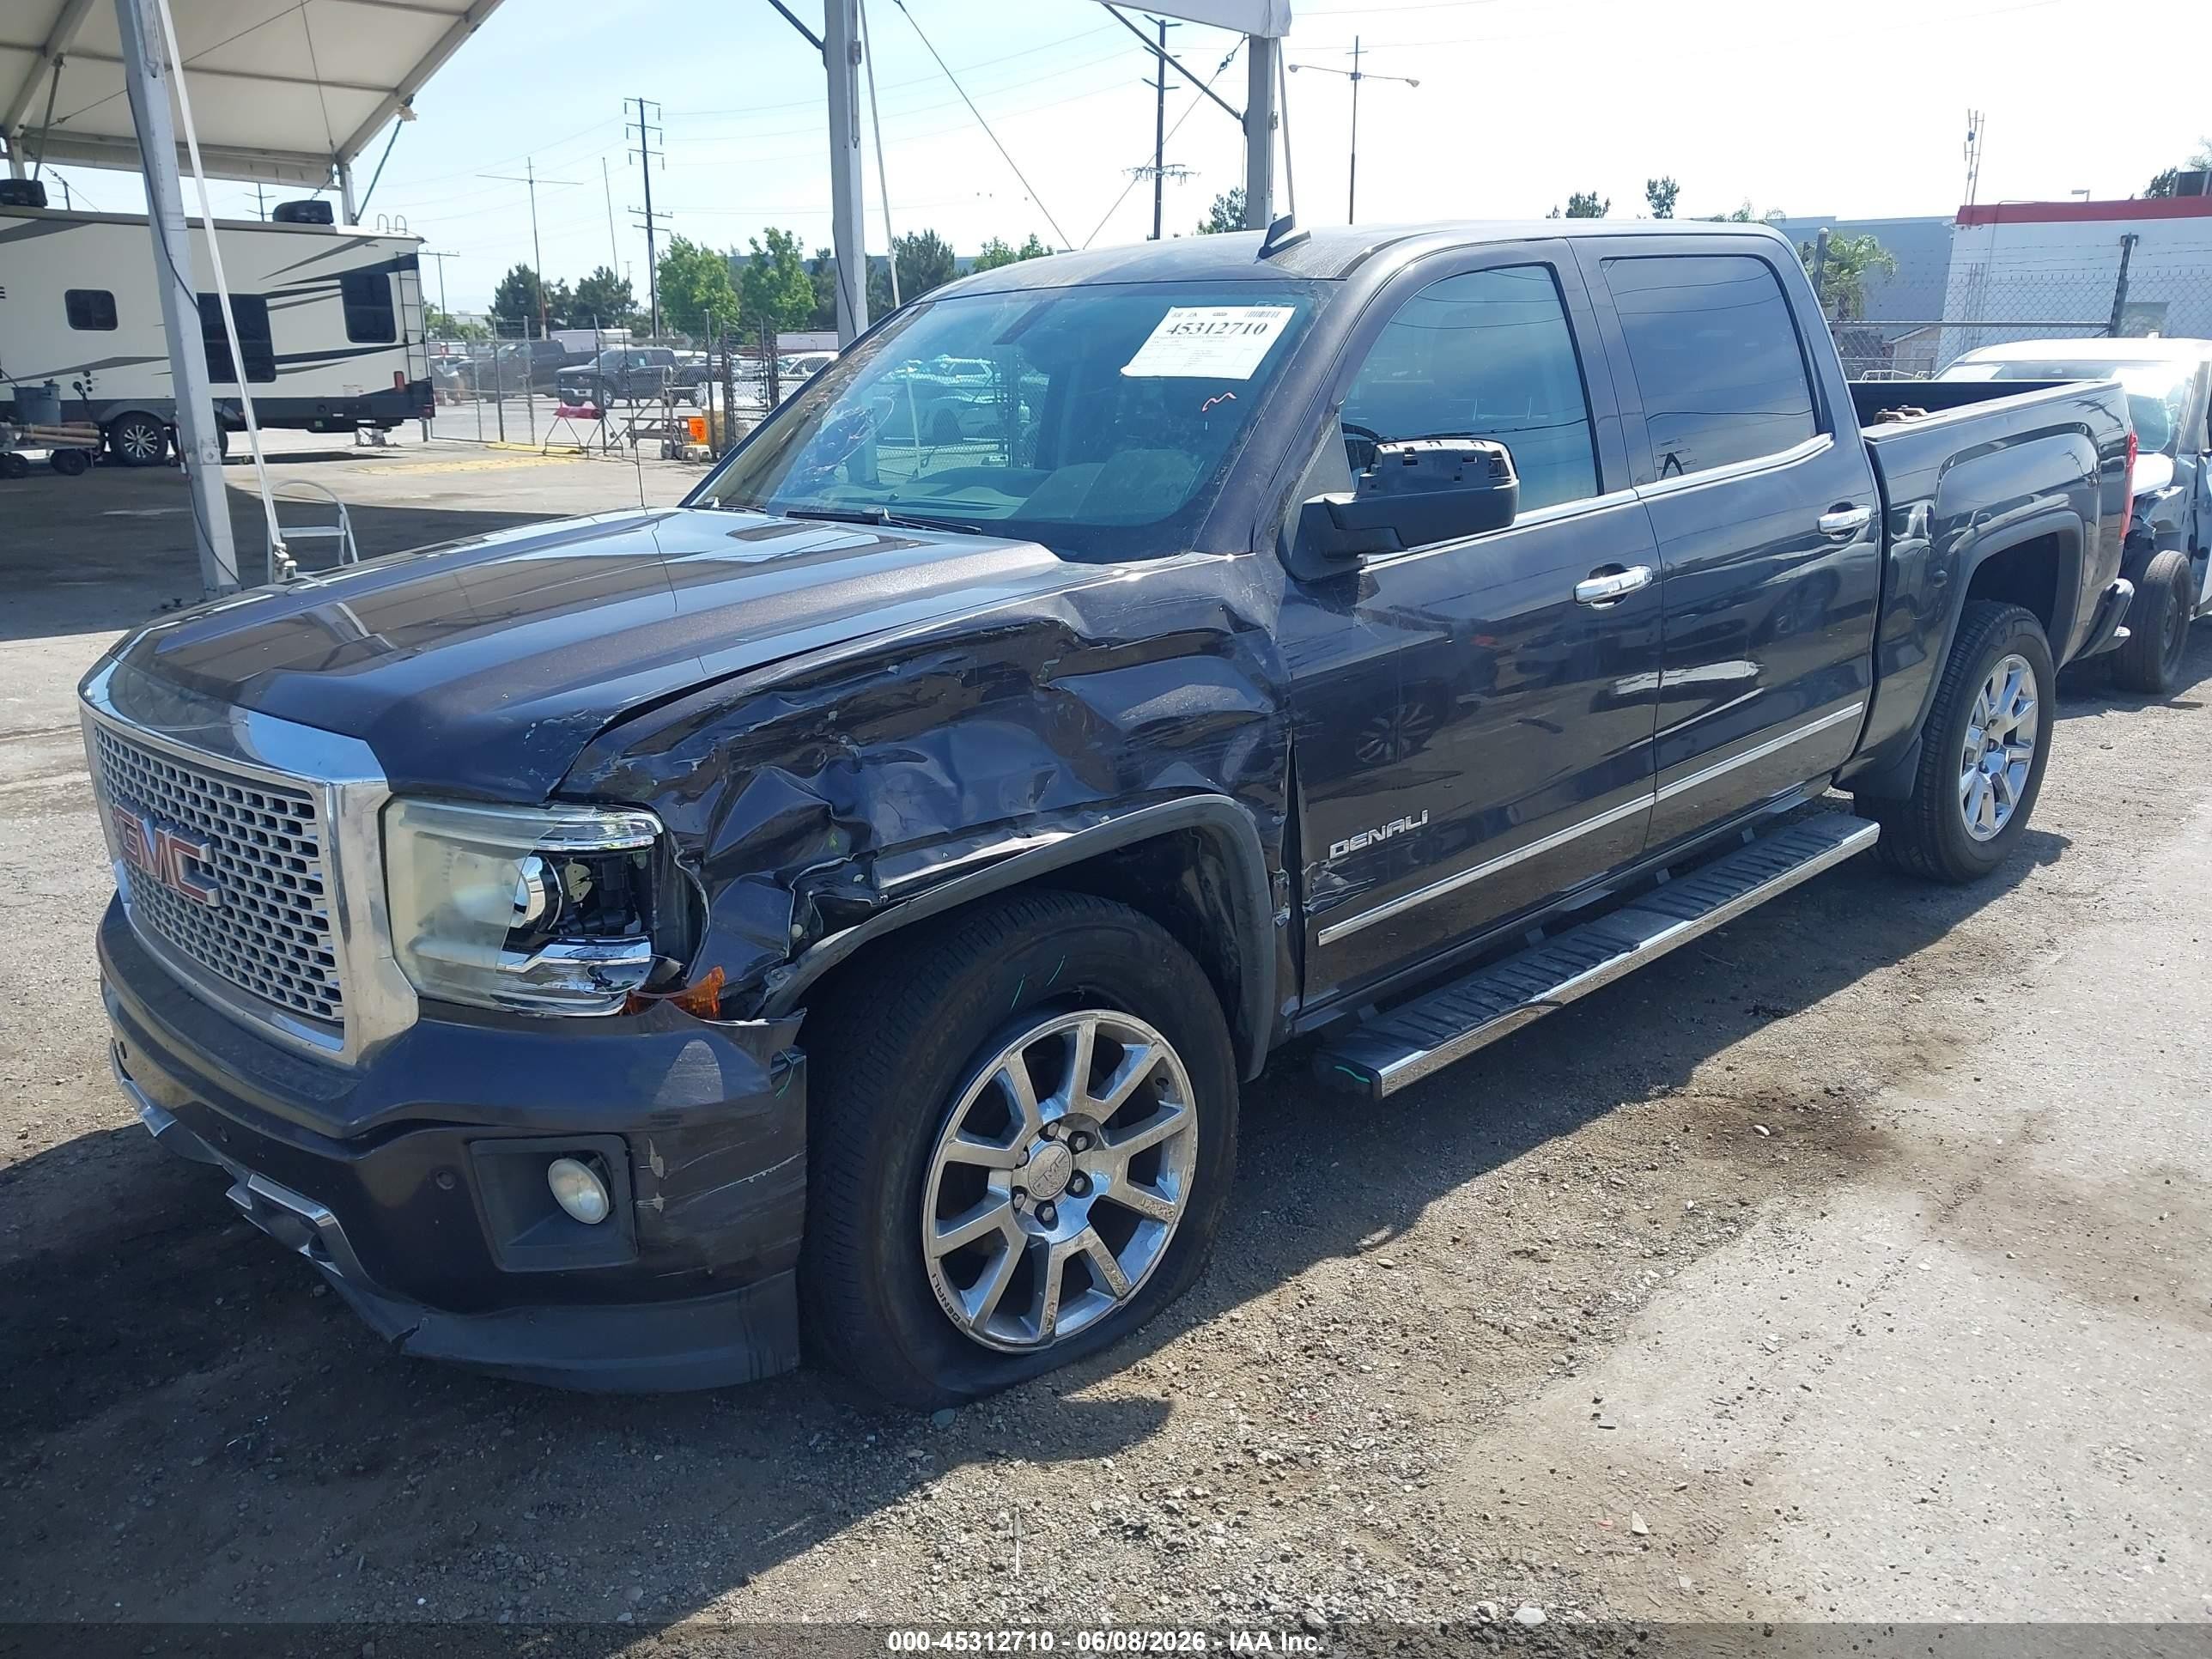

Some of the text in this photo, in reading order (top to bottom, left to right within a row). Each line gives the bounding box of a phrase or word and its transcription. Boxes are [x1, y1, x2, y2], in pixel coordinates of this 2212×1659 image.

[1166, 322, 1268, 336] 45312710
[114, 801, 220, 908] GMC
[1329, 809, 1429, 860] DENALI
[932, 1273, 961, 1322] DENALI
